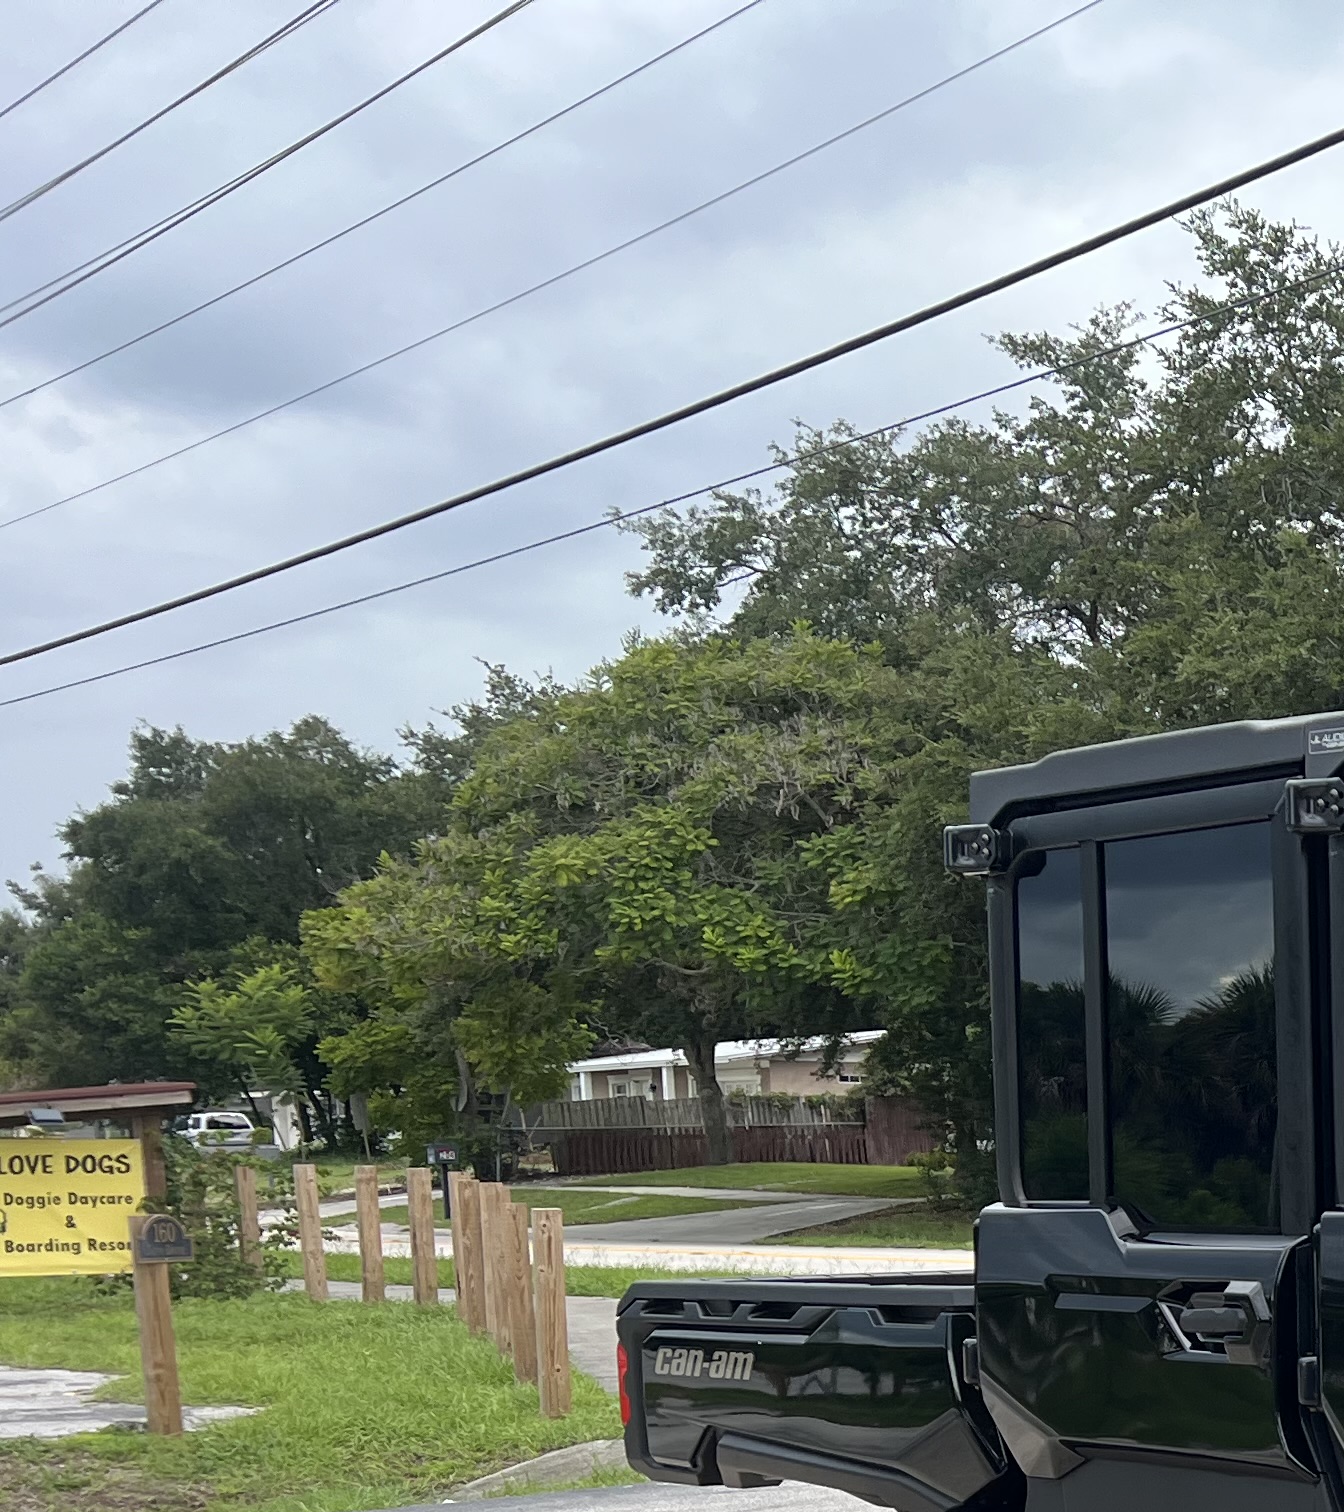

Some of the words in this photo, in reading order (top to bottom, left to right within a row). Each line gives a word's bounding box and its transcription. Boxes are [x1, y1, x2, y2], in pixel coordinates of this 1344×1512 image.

[65, 1154, 131, 1175] DOGS
[3, 1191, 61, 1209] Doggie
[68, 1191, 133, 1208] Daycare
[65, 1215, 77, 1228] &
[153, 1222, 177, 1243] 160
[4, 1238, 81, 1255] Boarding
[87, 1238, 131, 1251] Resor
[654, 1347, 754, 1381] can-am
